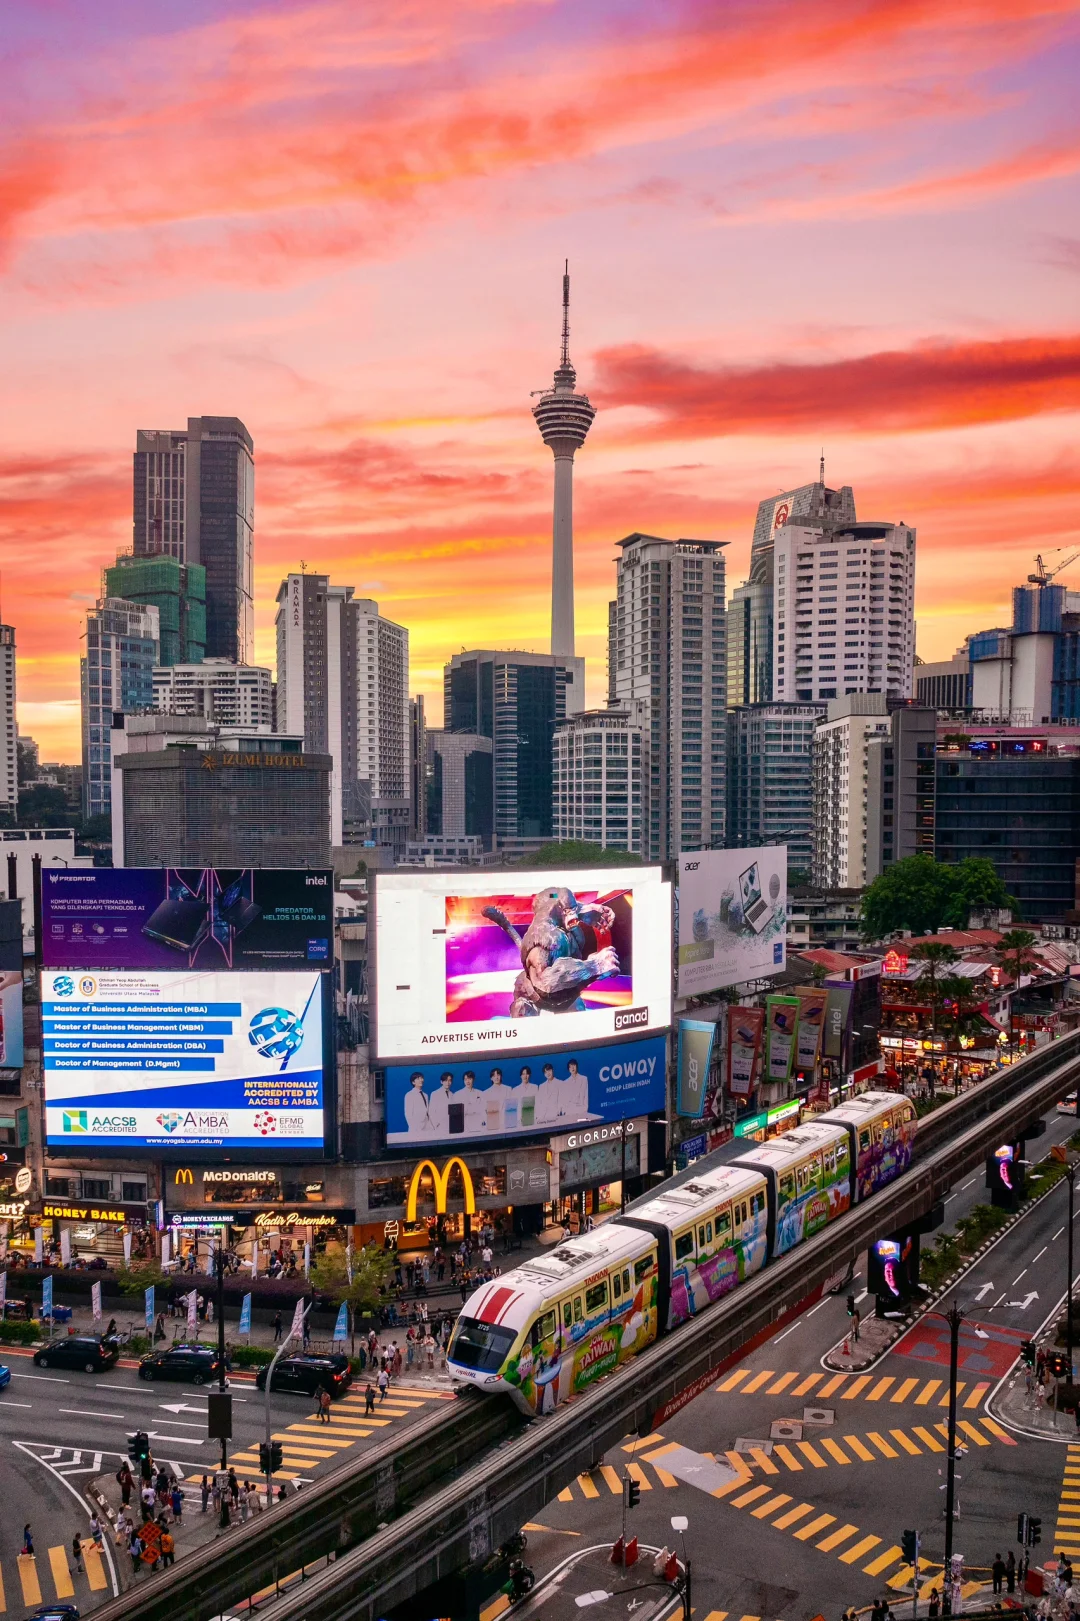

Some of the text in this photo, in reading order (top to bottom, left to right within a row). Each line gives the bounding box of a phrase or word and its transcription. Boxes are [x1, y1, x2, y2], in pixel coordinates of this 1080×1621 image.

[222, 754, 306, 767] IZUMI HOTEL
[684, 861, 700, 871] acer
[305, 876, 328, 886] intel
[615, 1007, 648, 1028] ganad
[830, 1008, 842, 1036] intel
[421, 1029, 518, 1044] ADVERTISE WITH US
[92, 1060, 142, 1068] Management
[145, 1060, 180, 1068] (D.Mgmt)
[688, 1052, 698, 1092] acer
[606, 1079, 650, 1093] HIDUP LEBIH INDAH
[92, 1116, 137, 1126] AACSB
[203, 1171, 276, 1182] McDonald's
[44, 1206, 125, 1221] HONEY BAKE
[255, 1211, 336, 1226] Kadir Pasembor
[584, 1268, 609, 1286] TAIWAN
[580, 1339, 616, 1369] TAIWAN
[521, 1360, 534, 1371] 2725
